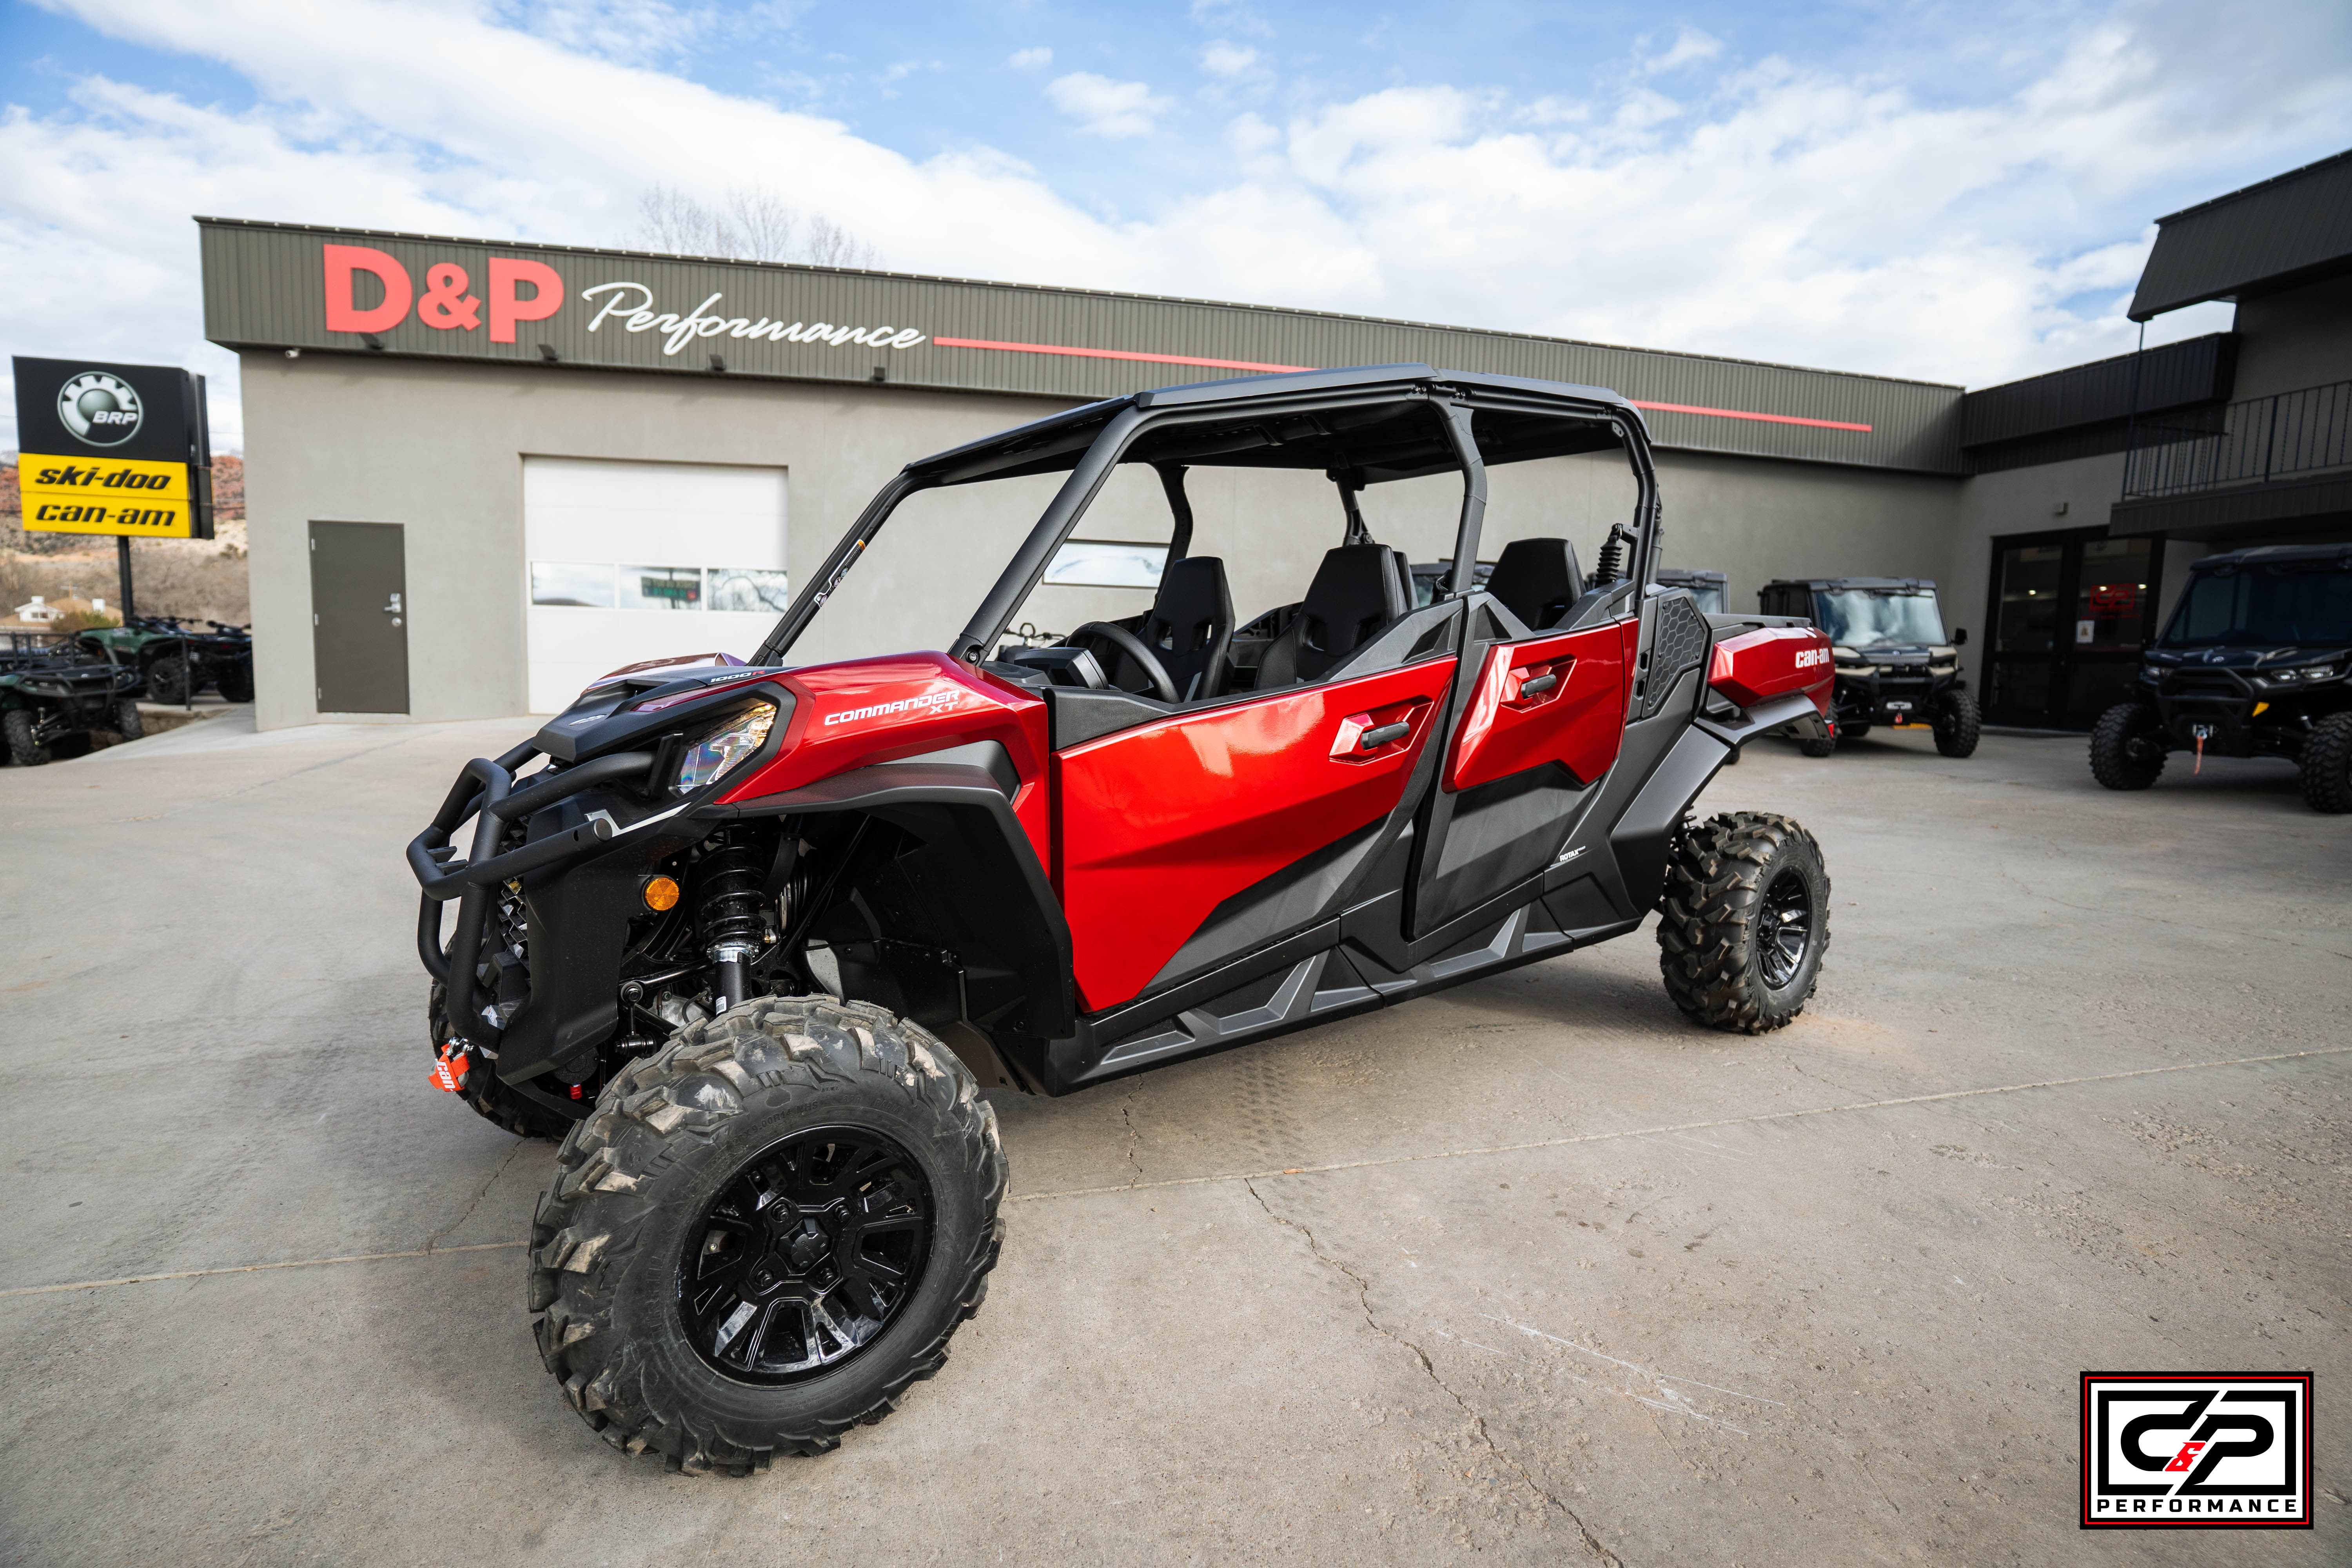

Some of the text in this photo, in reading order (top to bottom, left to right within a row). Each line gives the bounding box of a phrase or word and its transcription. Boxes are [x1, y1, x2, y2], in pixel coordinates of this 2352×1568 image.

[324, 244, 926, 356] D&P Performance
[93, 410, 138, 425] BRP
[35, 466, 171, 490] ski-doo
[36, 505, 175, 526] can-am
[1795, 647, 1829, 669] can-am
[711, 670, 766, 683] 1000R
[824, 690, 960, 726] COMMANDER
[928, 701, 958, 715] XT
[1559, 849, 1579, 862] ROTAX
